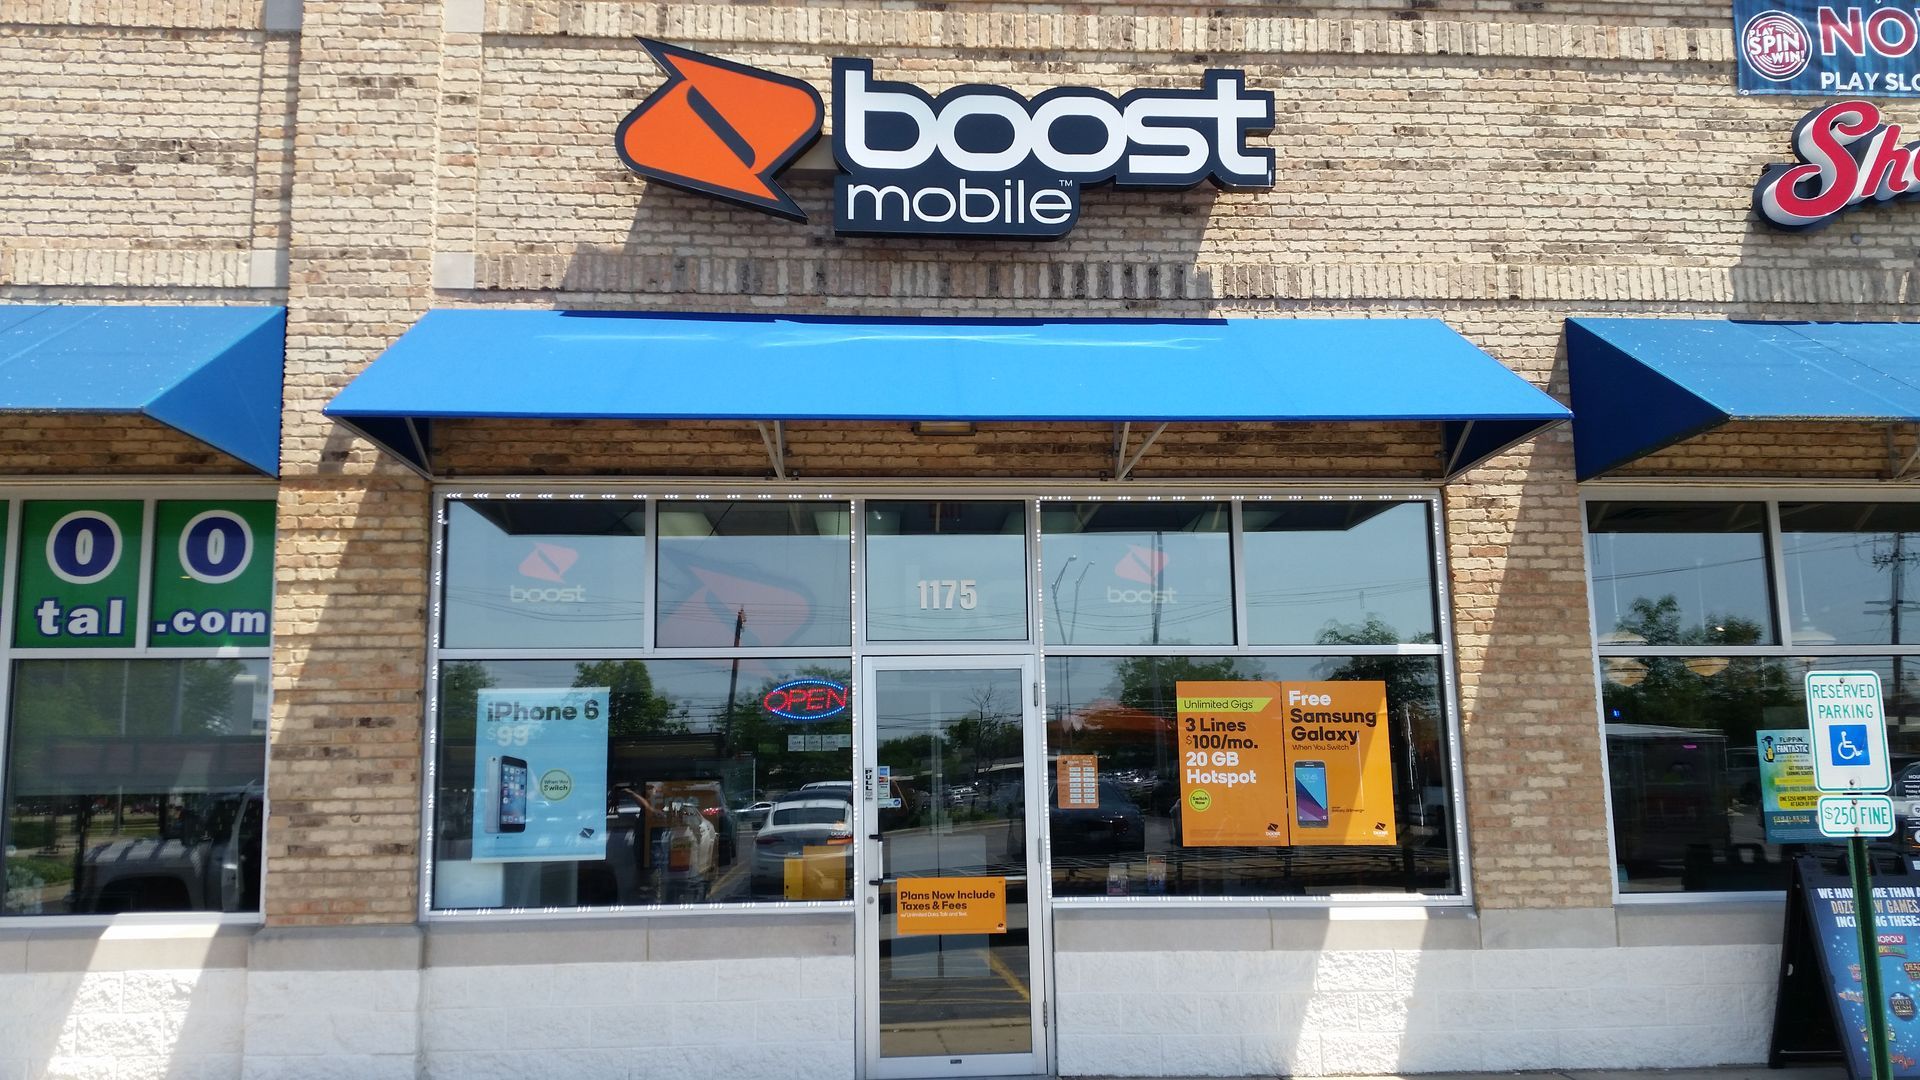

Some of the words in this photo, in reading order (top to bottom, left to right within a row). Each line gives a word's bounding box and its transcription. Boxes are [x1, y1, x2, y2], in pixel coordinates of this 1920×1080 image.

[1750, 27, 1775, 37] PLAY
[1818, 6, 1920, 58] NO
[1748, 33, 1799, 56] SPIN
[1772, 50, 1805, 64] WIN!
[1821, 72, 1879, 90] PLAY
[845, 70, 1267, 175] boost
[1775, 100, 1920, 218] Sh
[847, 178, 1072, 224] mobile
[510, 584, 586, 603] boost
[917, 579, 978, 610] 1175
[1106, 585, 1178, 604] boost
[154, 609, 268, 637] .com
[763, 687, 848, 711] OPEN
[1288, 690, 1332, 706] Free
[1812, 684, 1875, 699] RESERVED
[487, 700, 578, 722] iPhone
[584, 699, 599, 721] 6
[1184, 699, 1229, 709] Unlimited
[1818, 704, 1874, 719] PARKING
[1185, 718, 1196, 732] 3
[1200, 718, 1247, 732] Lines
[1290, 708, 1377, 728] Samsung
[1186, 734, 1259, 749] $100/mo.
[1291, 726, 1359, 745] Galaxy
[1186, 752, 1208, 766] 20
[1211, 752, 1239, 766] GB
[864, 768, 873, 791] PULL
[1186, 769, 1257, 788] Hotspot
[1824, 806, 1857, 825] $250
[1860, 806, 1889, 825] FINE
[900, 891, 930, 900] Plans
[931, 891, 956, 900] Now
[957, 890, 996, 899] Include
[1817, 888, 1834, 898] WE
[1834, 888, 1854, 898] HAV
[1872, 887, 1888, 898] RE
[1888, 887, 1915, 898] THAN
[900, 901, 930, 911] Taxes
[932, 901, 940, 910] &
[941, 900, 967, 910] Fees
[1831, 901, 1855, 914] DOZE
[1888, 915, 1920, 927] THESE:
